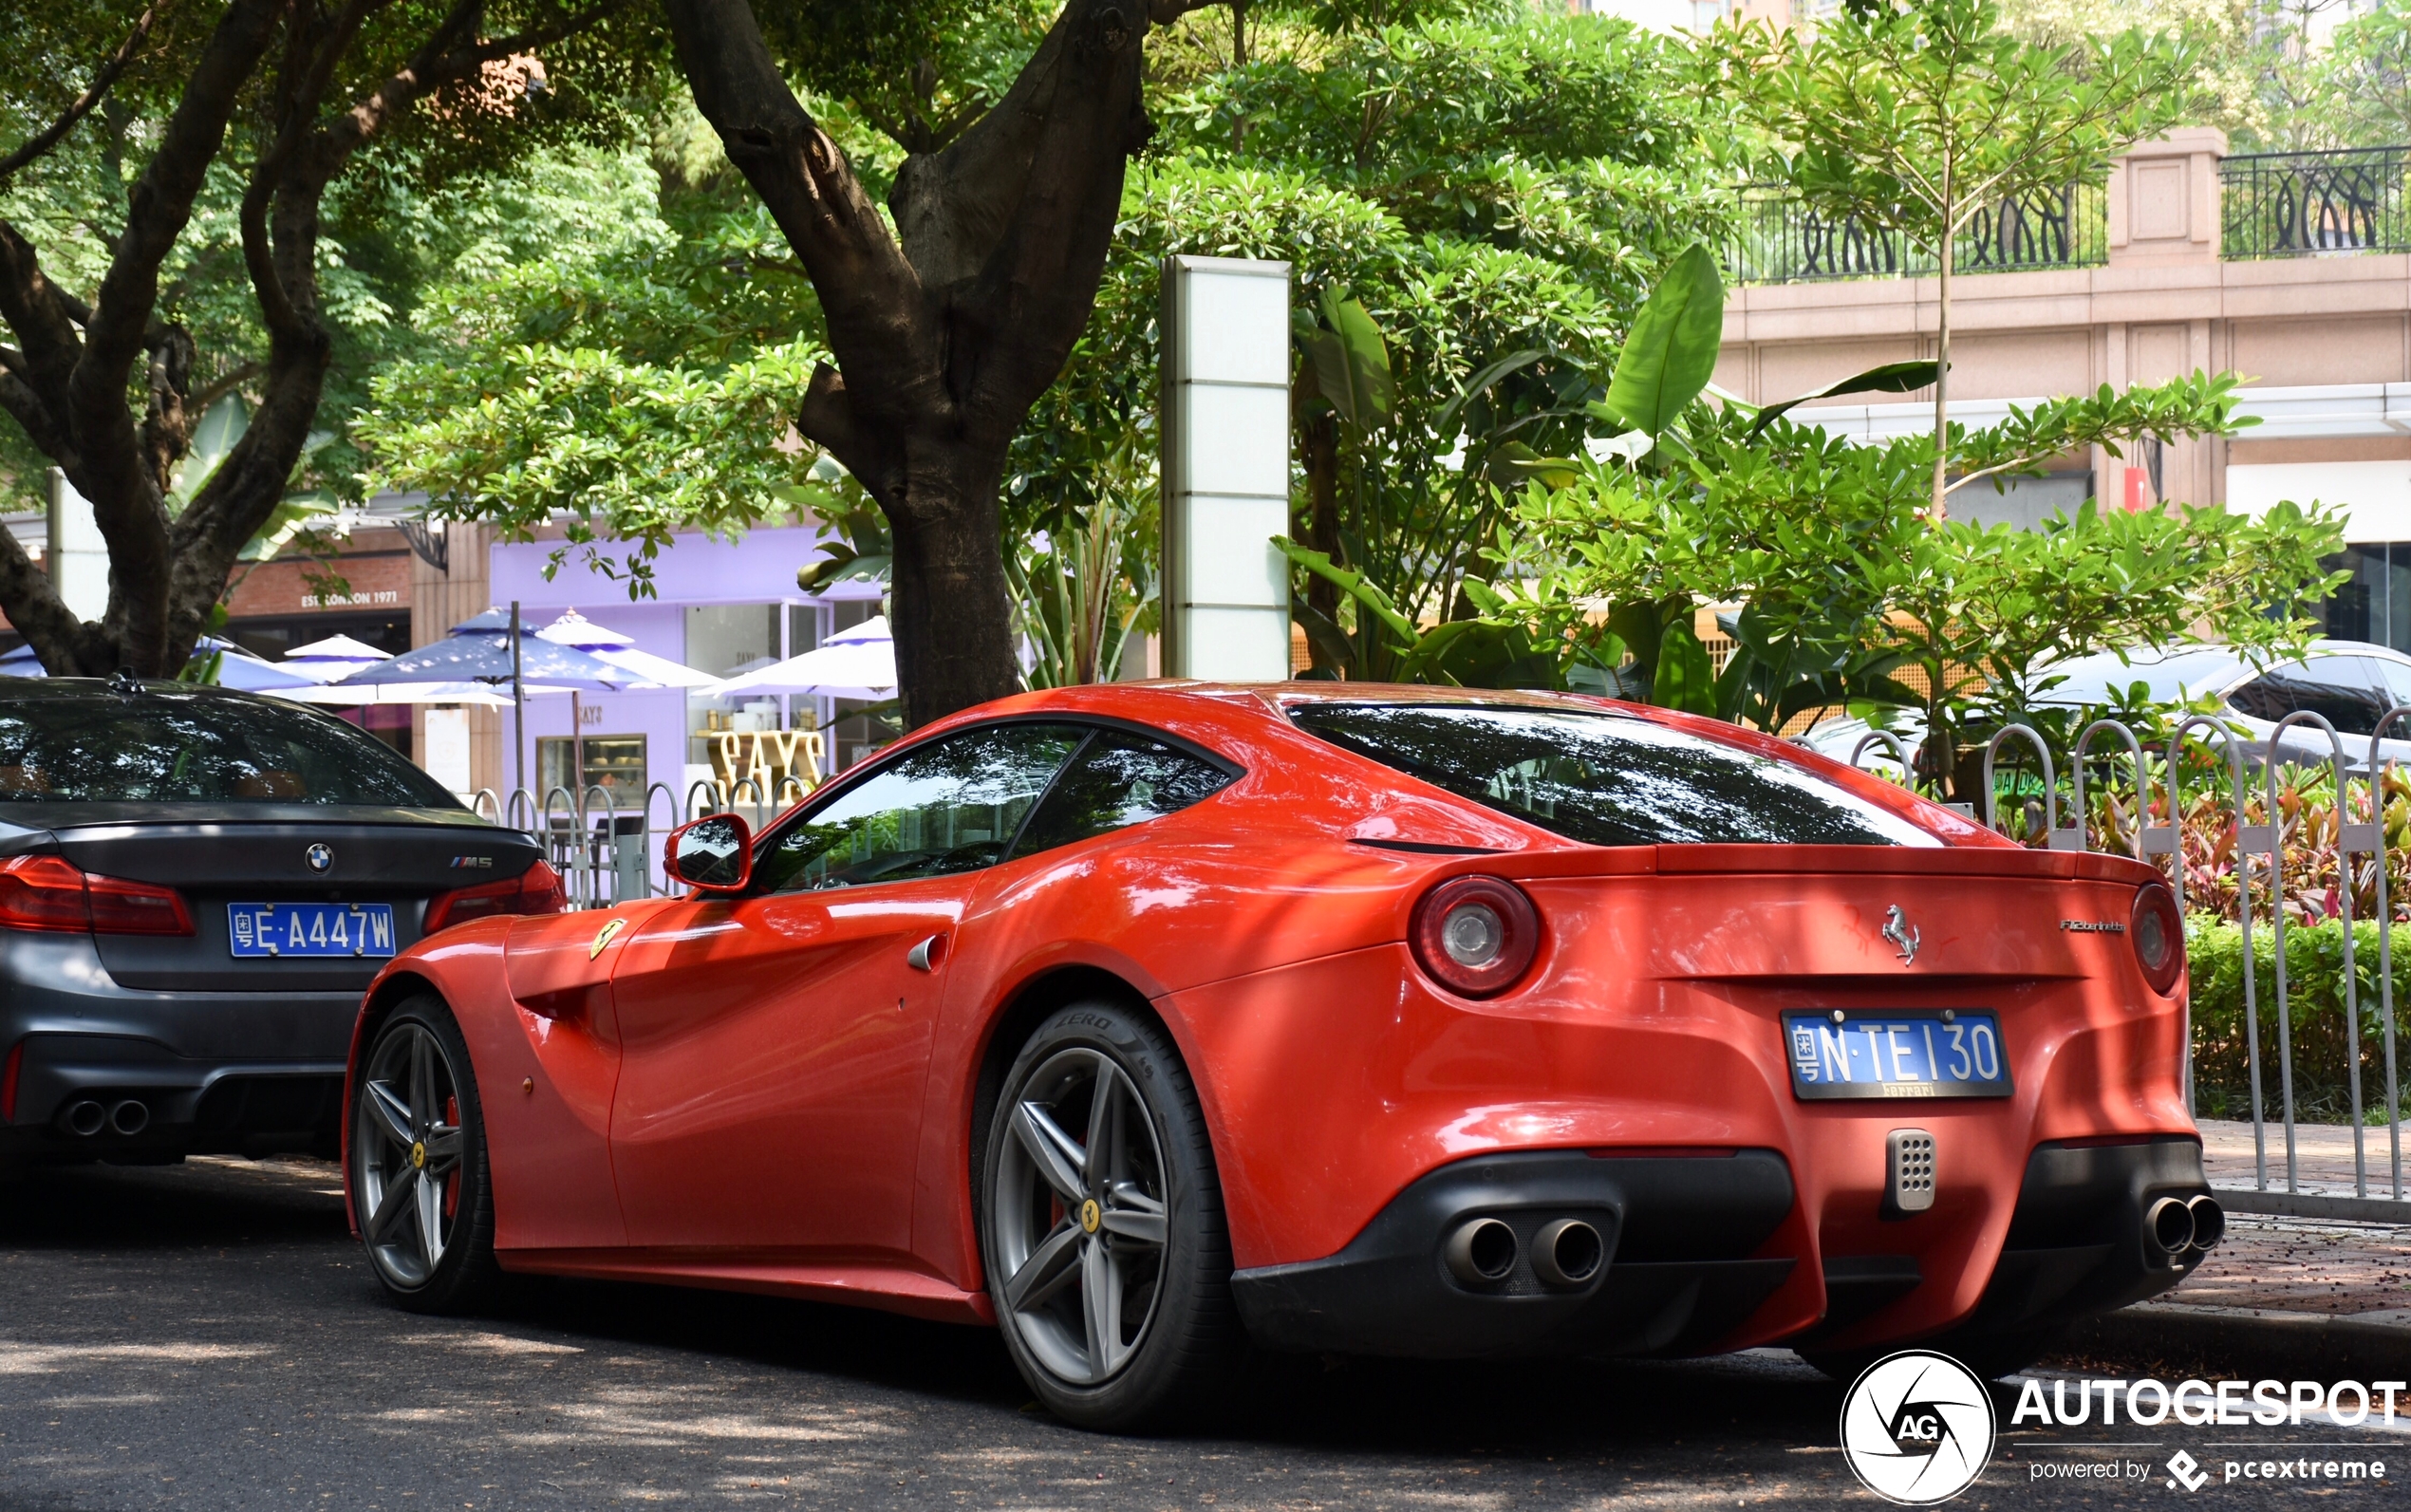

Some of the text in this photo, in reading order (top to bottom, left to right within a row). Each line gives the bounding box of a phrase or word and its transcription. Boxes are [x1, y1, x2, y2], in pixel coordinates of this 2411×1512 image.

[374, 590, 397, 603] 1971
[710, 730, 826, 807] SAYS
[459, 856, 493, 868] M5
[1054, 1012, 1113, 1031] ZERO
[1881, 1082, 1936, 1098] Ferrari
